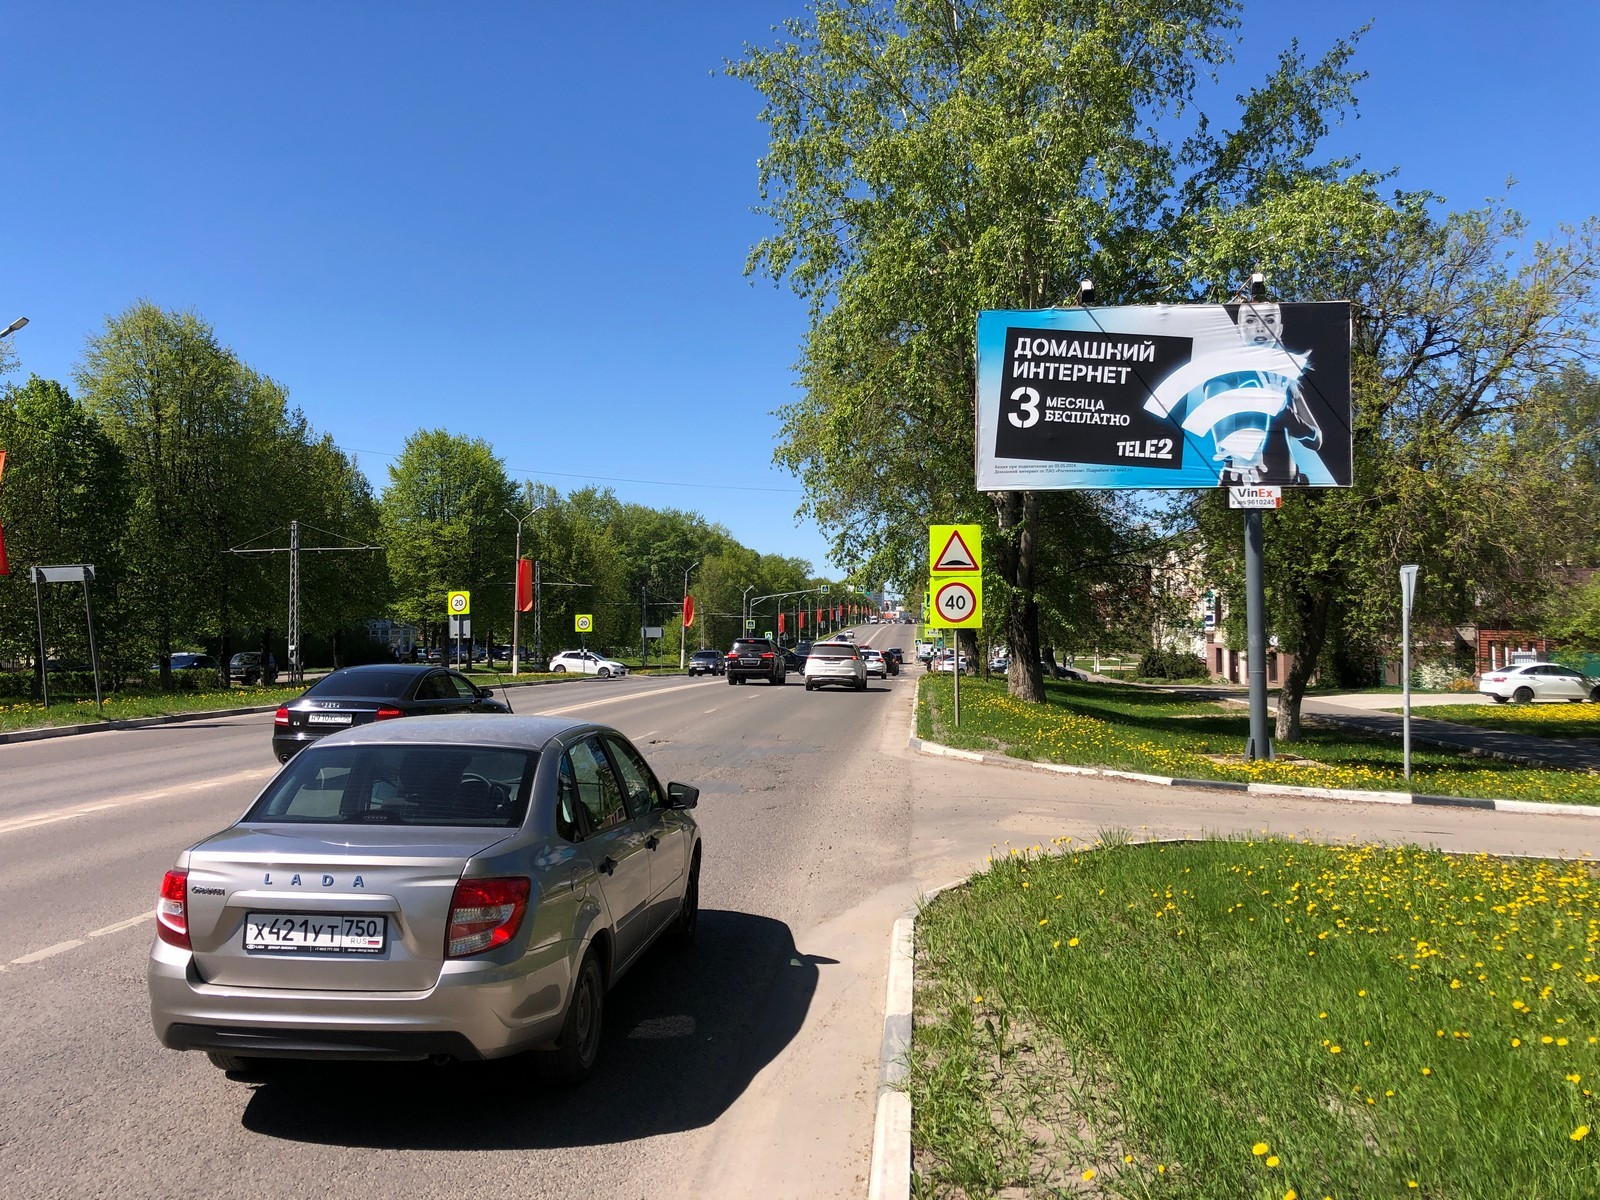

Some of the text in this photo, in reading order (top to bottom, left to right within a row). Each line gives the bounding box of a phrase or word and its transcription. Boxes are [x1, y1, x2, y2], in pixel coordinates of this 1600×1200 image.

[1014, 337, 1156, 362] ДОМАШНИЙ
[1012, 361, 1132, 384] ИНТЕРНЕТ
[1008, 386, 1041, 429] 3
[1046, 396, 1105, 412] МЕСЯЦА
[1044, 410, 1131, 427] БЕСПЛАТНО
[1116, 438, 1174, 460] TELE2
[1237, 488, 1273, 498] VinEx
[454, 599, 464, 607] 20
[945, 594, 966, 610] 40
[264, 872, 365, 888] LADA
[344, 919, 378, 938] 750
[350, 937, 368, 945] RUS
